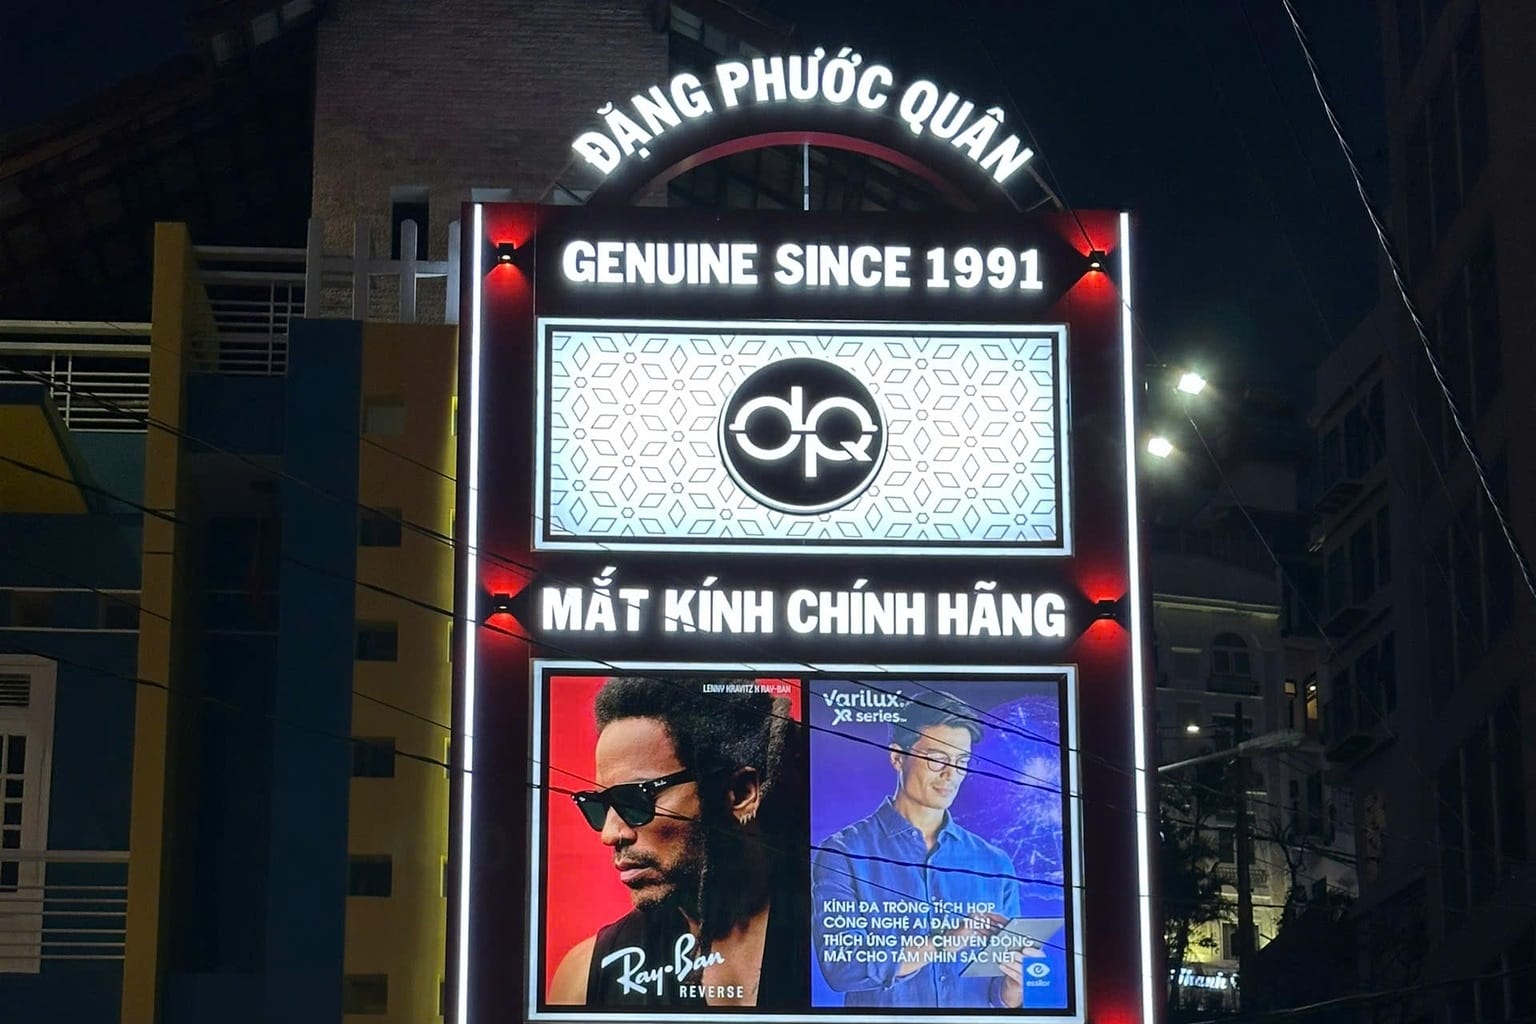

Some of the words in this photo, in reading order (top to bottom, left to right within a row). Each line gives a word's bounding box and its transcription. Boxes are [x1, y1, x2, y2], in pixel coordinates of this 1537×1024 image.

[571, 70, 714, 177] ĐẶNG
[715, 46, 893, 110] PHƯỚC
[900, 79, 1034, 184] QUÂN
[562, 241, 758, 286] GENUINE
[774, 244, 911, 289] SINCE
[926, 247, 1043, 291] 1991
[542, 566, 650, 631] MẮT
[664, 576, 772, 634] KÍNH
[787, 578, 926, 637] CHÍNH
[938, 580, 1066, 638] HÃNG
[824, 898, 855, 914] KÍNH
[859, 901, 879, 914] ĐA
[883, 899, 930, 914] TRÒNG
[967, 901, 995, 916] HỢP
[824, 914, 868, 929] CÔNG
[872, 914, 910, 932] NGHỆ
[913, 917, 928, 929] AI
[824, 932, 863, 947] THÍCH
[867, 931, 897, 947] ỨNG
[901, 934, 929, 949] MỌI
[856, 951, 888, 963] CHO
[923, 947, 957, 963] NHÌN
[679, 986, 744, 998] REVERSE
